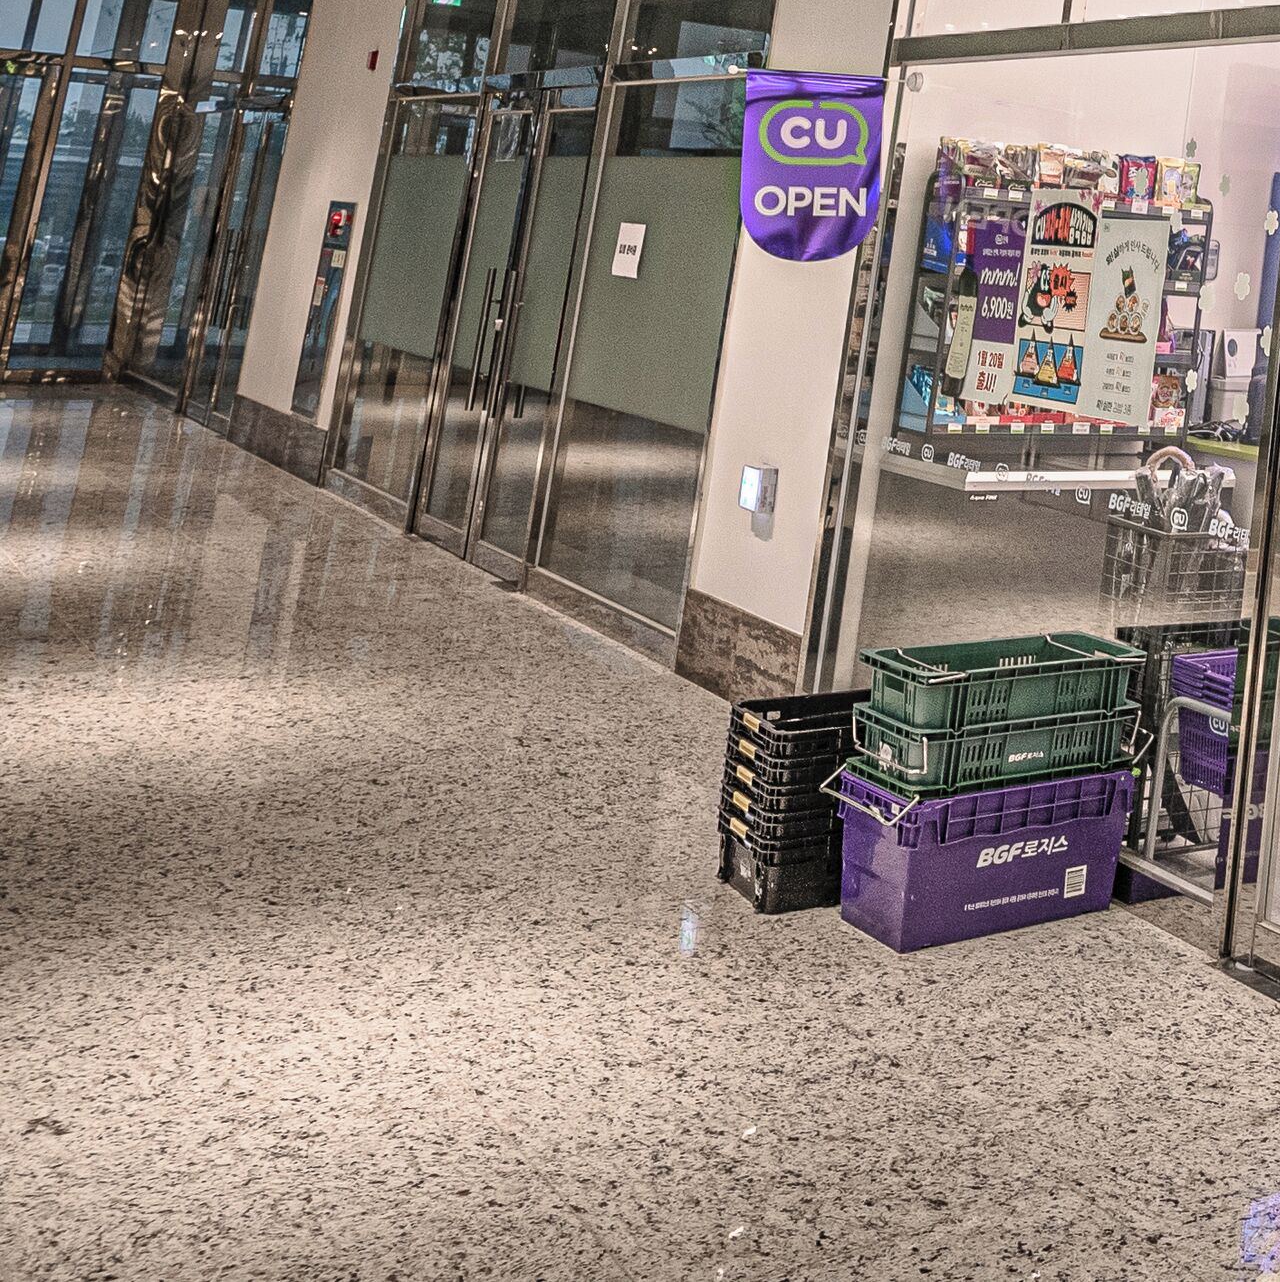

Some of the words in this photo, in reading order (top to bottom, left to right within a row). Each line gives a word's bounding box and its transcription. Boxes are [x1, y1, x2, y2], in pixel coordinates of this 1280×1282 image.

[780, 116, 848, 150] CU
[754, 185, 868, 218] OPEN
[981, 295, 1015, 320] 6,900원
[1078, 485, 1090, 500] CU
[1008, 750, 1044, 763] BGF로지스
[976, 835, 1069, 868] BGF로지스
